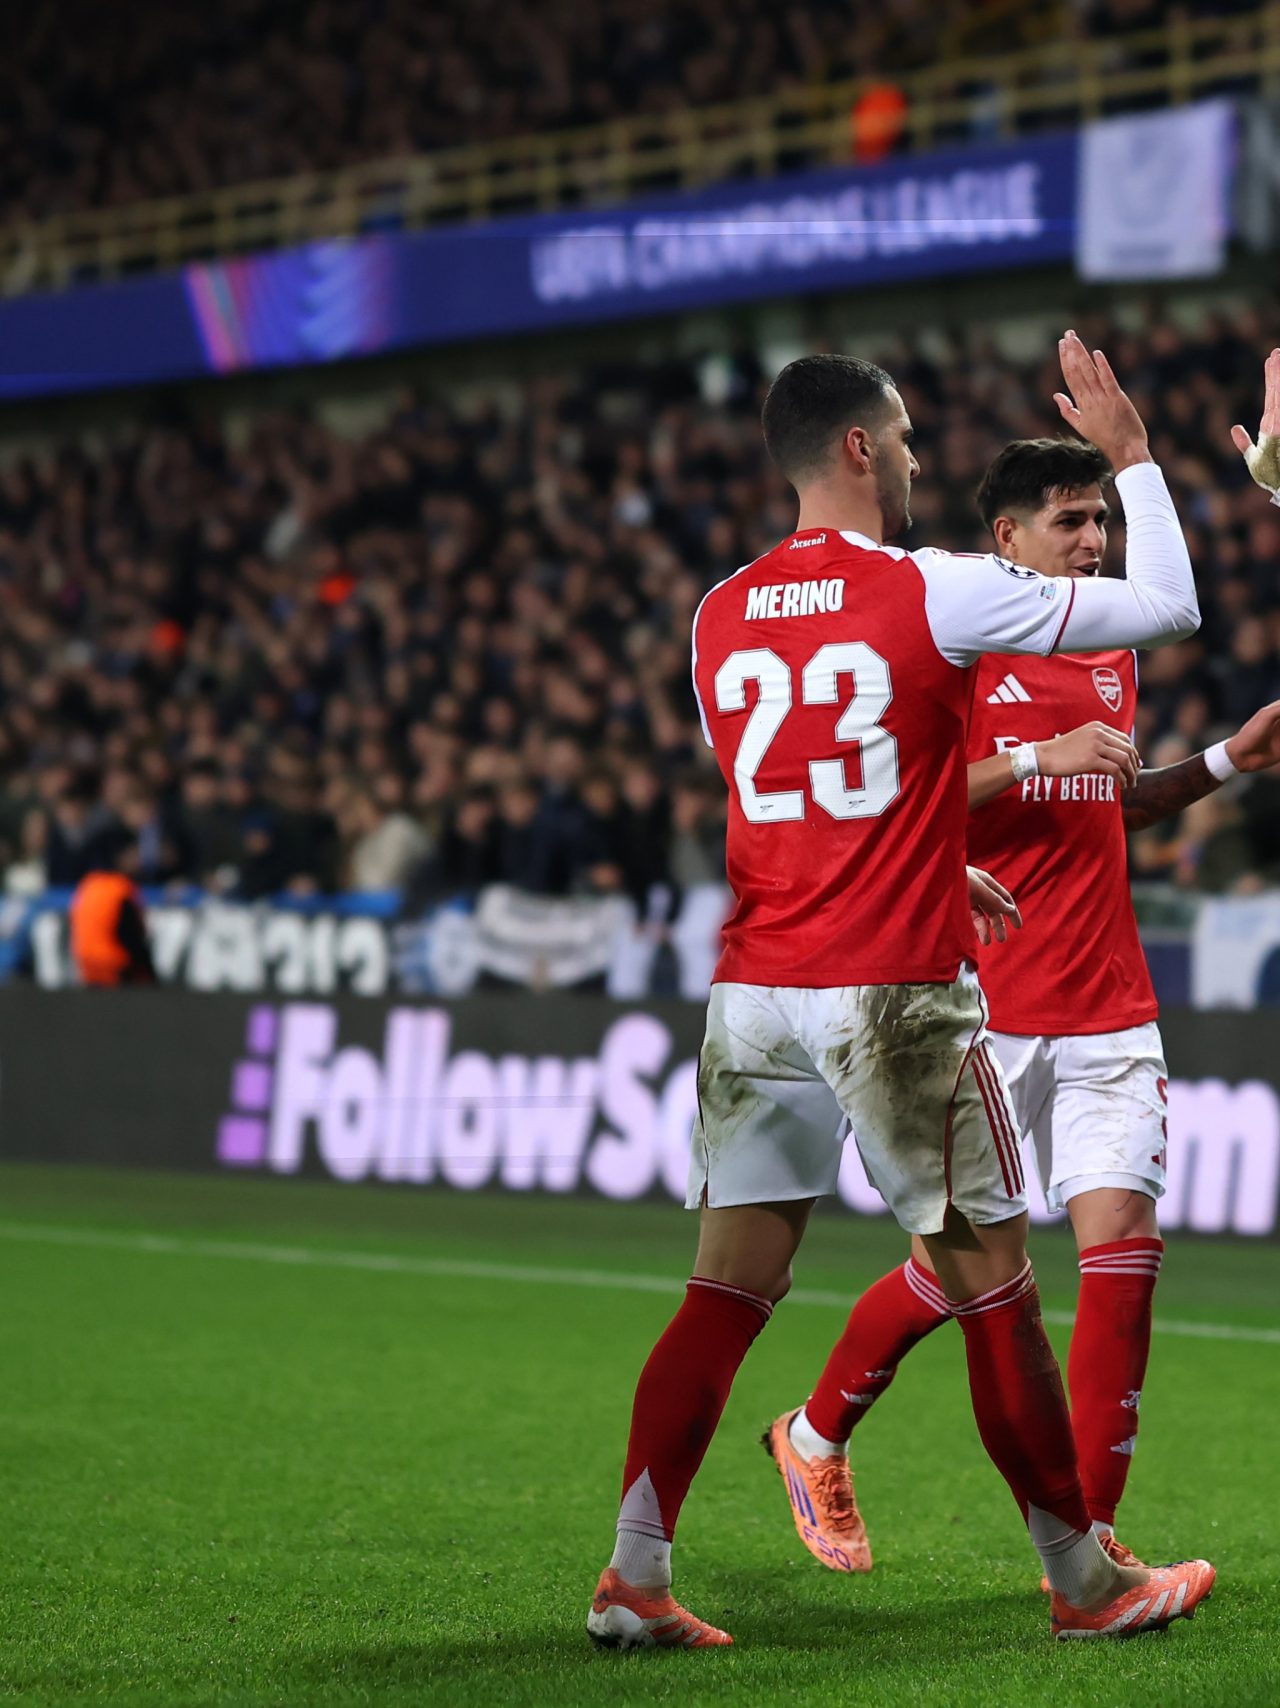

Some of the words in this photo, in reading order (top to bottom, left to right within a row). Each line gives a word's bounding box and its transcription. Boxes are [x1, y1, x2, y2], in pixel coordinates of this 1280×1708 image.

[789, 532, 827, 551] Arsenal
[744, 578, 846, 621] MERINO
[714, 641, 901, 823] 23
[1021, 774, 1054, 802] FLY
[1060, 773, 1115, 802] BETTER
